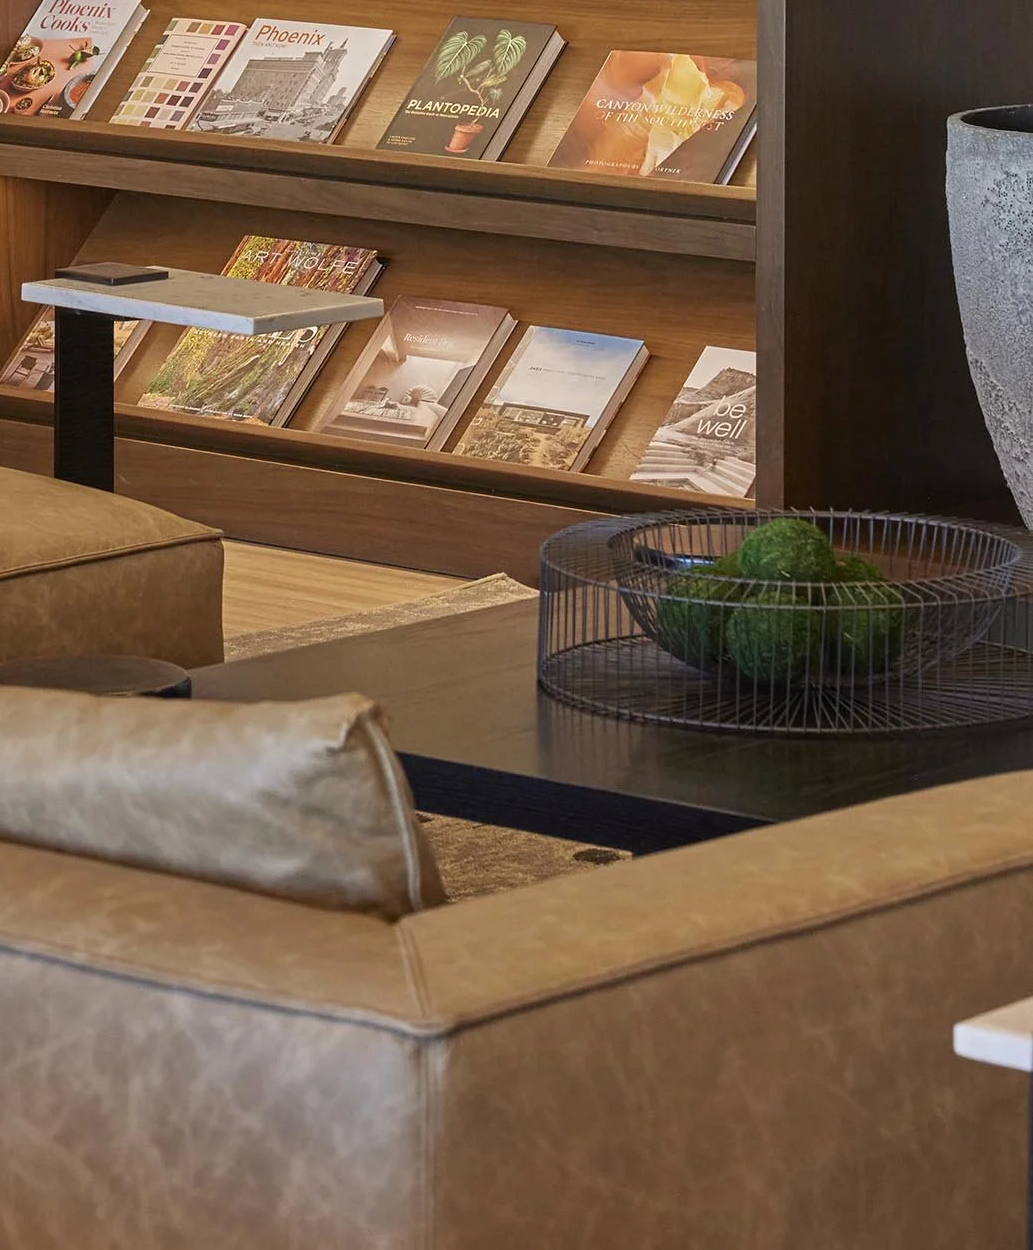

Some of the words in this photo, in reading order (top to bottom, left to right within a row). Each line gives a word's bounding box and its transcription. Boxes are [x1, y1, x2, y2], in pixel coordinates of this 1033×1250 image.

[40, 14, 90, 32] Cooks
[255, 25, 325, 45] Phoenix
[407, 99, 500, 118] PLANTOPEDIA
[596, 99, 651, 112] CANYON
[654, 104, 735, 121] WILDERNESS
[240, 251, 283, 264] ART
[288, 254, 359, 275] WOLFE
[713, 395, 746, 418] be
[697, 419, 747, 439] well
